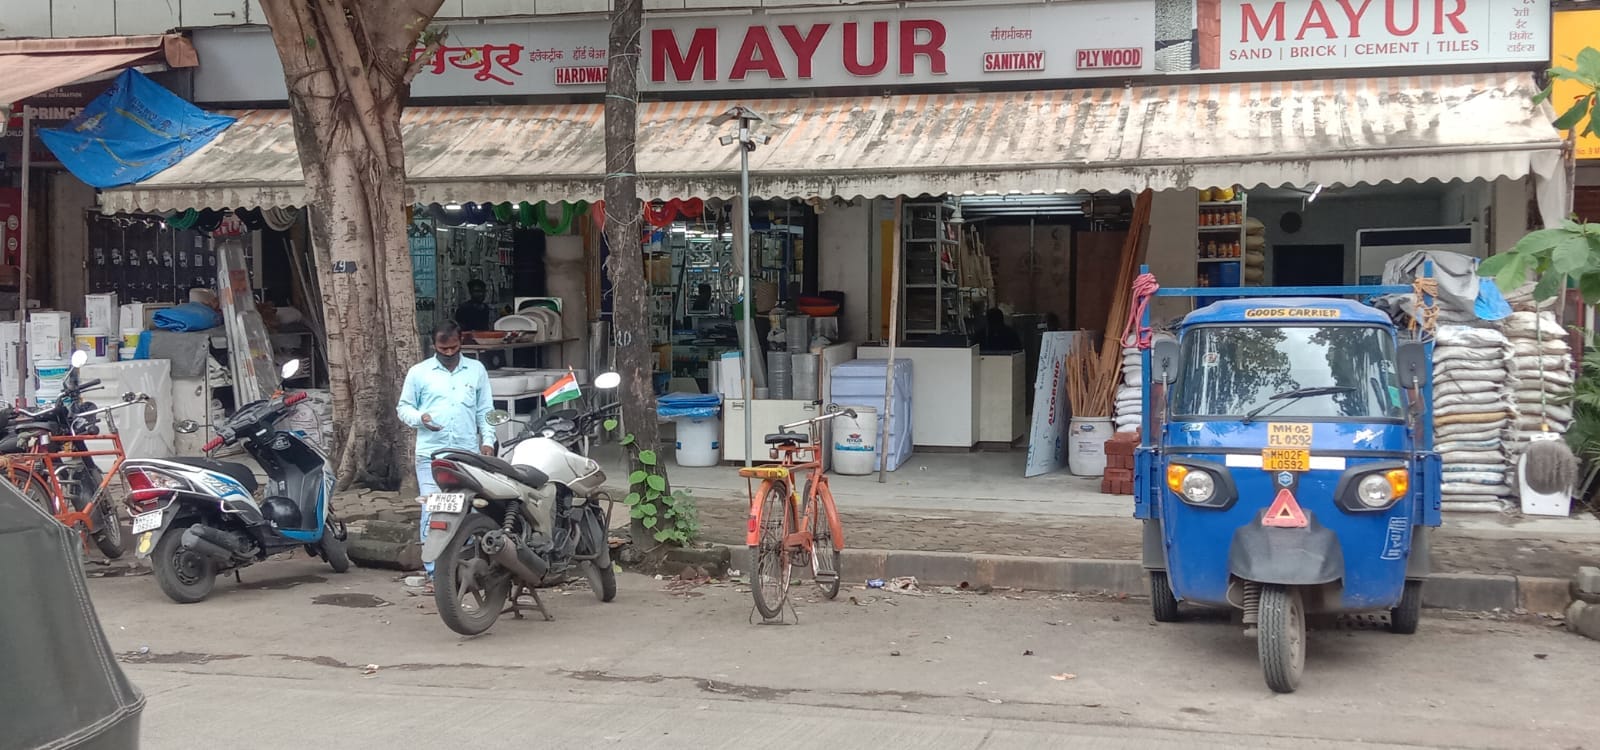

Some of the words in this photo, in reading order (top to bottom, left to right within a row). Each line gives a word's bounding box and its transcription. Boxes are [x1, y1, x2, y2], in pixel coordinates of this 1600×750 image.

[1240, 0, 1470, 43] MAYUR
[651, 18, 948, 83] MAYUR
[1230, 48, 1273, 60] SAND
[1289, 45, 1338, 58] BRICK
[1354, 41, 1420, 55] CEMENT
[1436, 39, 1480, 53] TILES
[985, 52, 1043, 70] SANITARY
[556, 67, 608, 84] HARDWAR
[1246, 308, 1285, 317] GOODS
[1288, 308, 1337, 318] CARRIER
[1272, 424, 1292, 433] MH
[1294, 425, 1309, 434] 02
[1270, 434, 1283, 445] FL
[1284, 434, 1312, 446] 0592
[1271, 450, 1303, 460] MH02F
[1271, 460, 1304, 470] L0592
[435, 494, 458, 503] MH02
